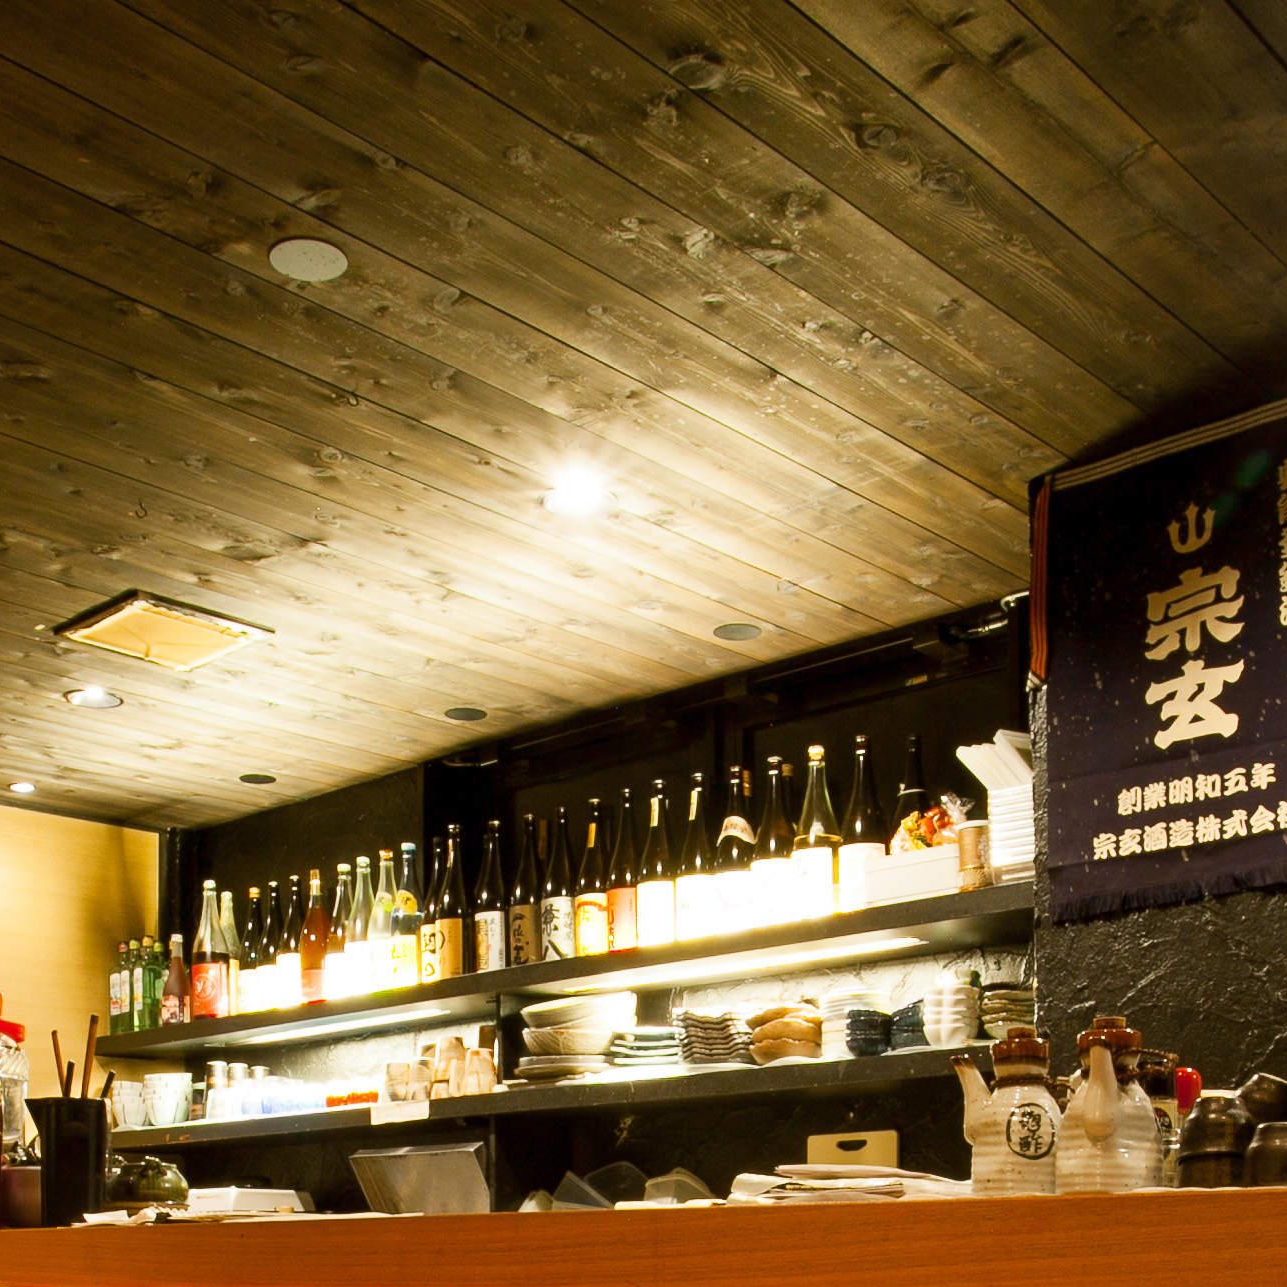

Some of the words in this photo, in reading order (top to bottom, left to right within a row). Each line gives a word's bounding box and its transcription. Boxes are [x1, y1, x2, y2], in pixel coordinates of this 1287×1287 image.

[1145, 566, 1245, 750] 宗玄
[1117, 762, 1277, 816] 創業明和五年
